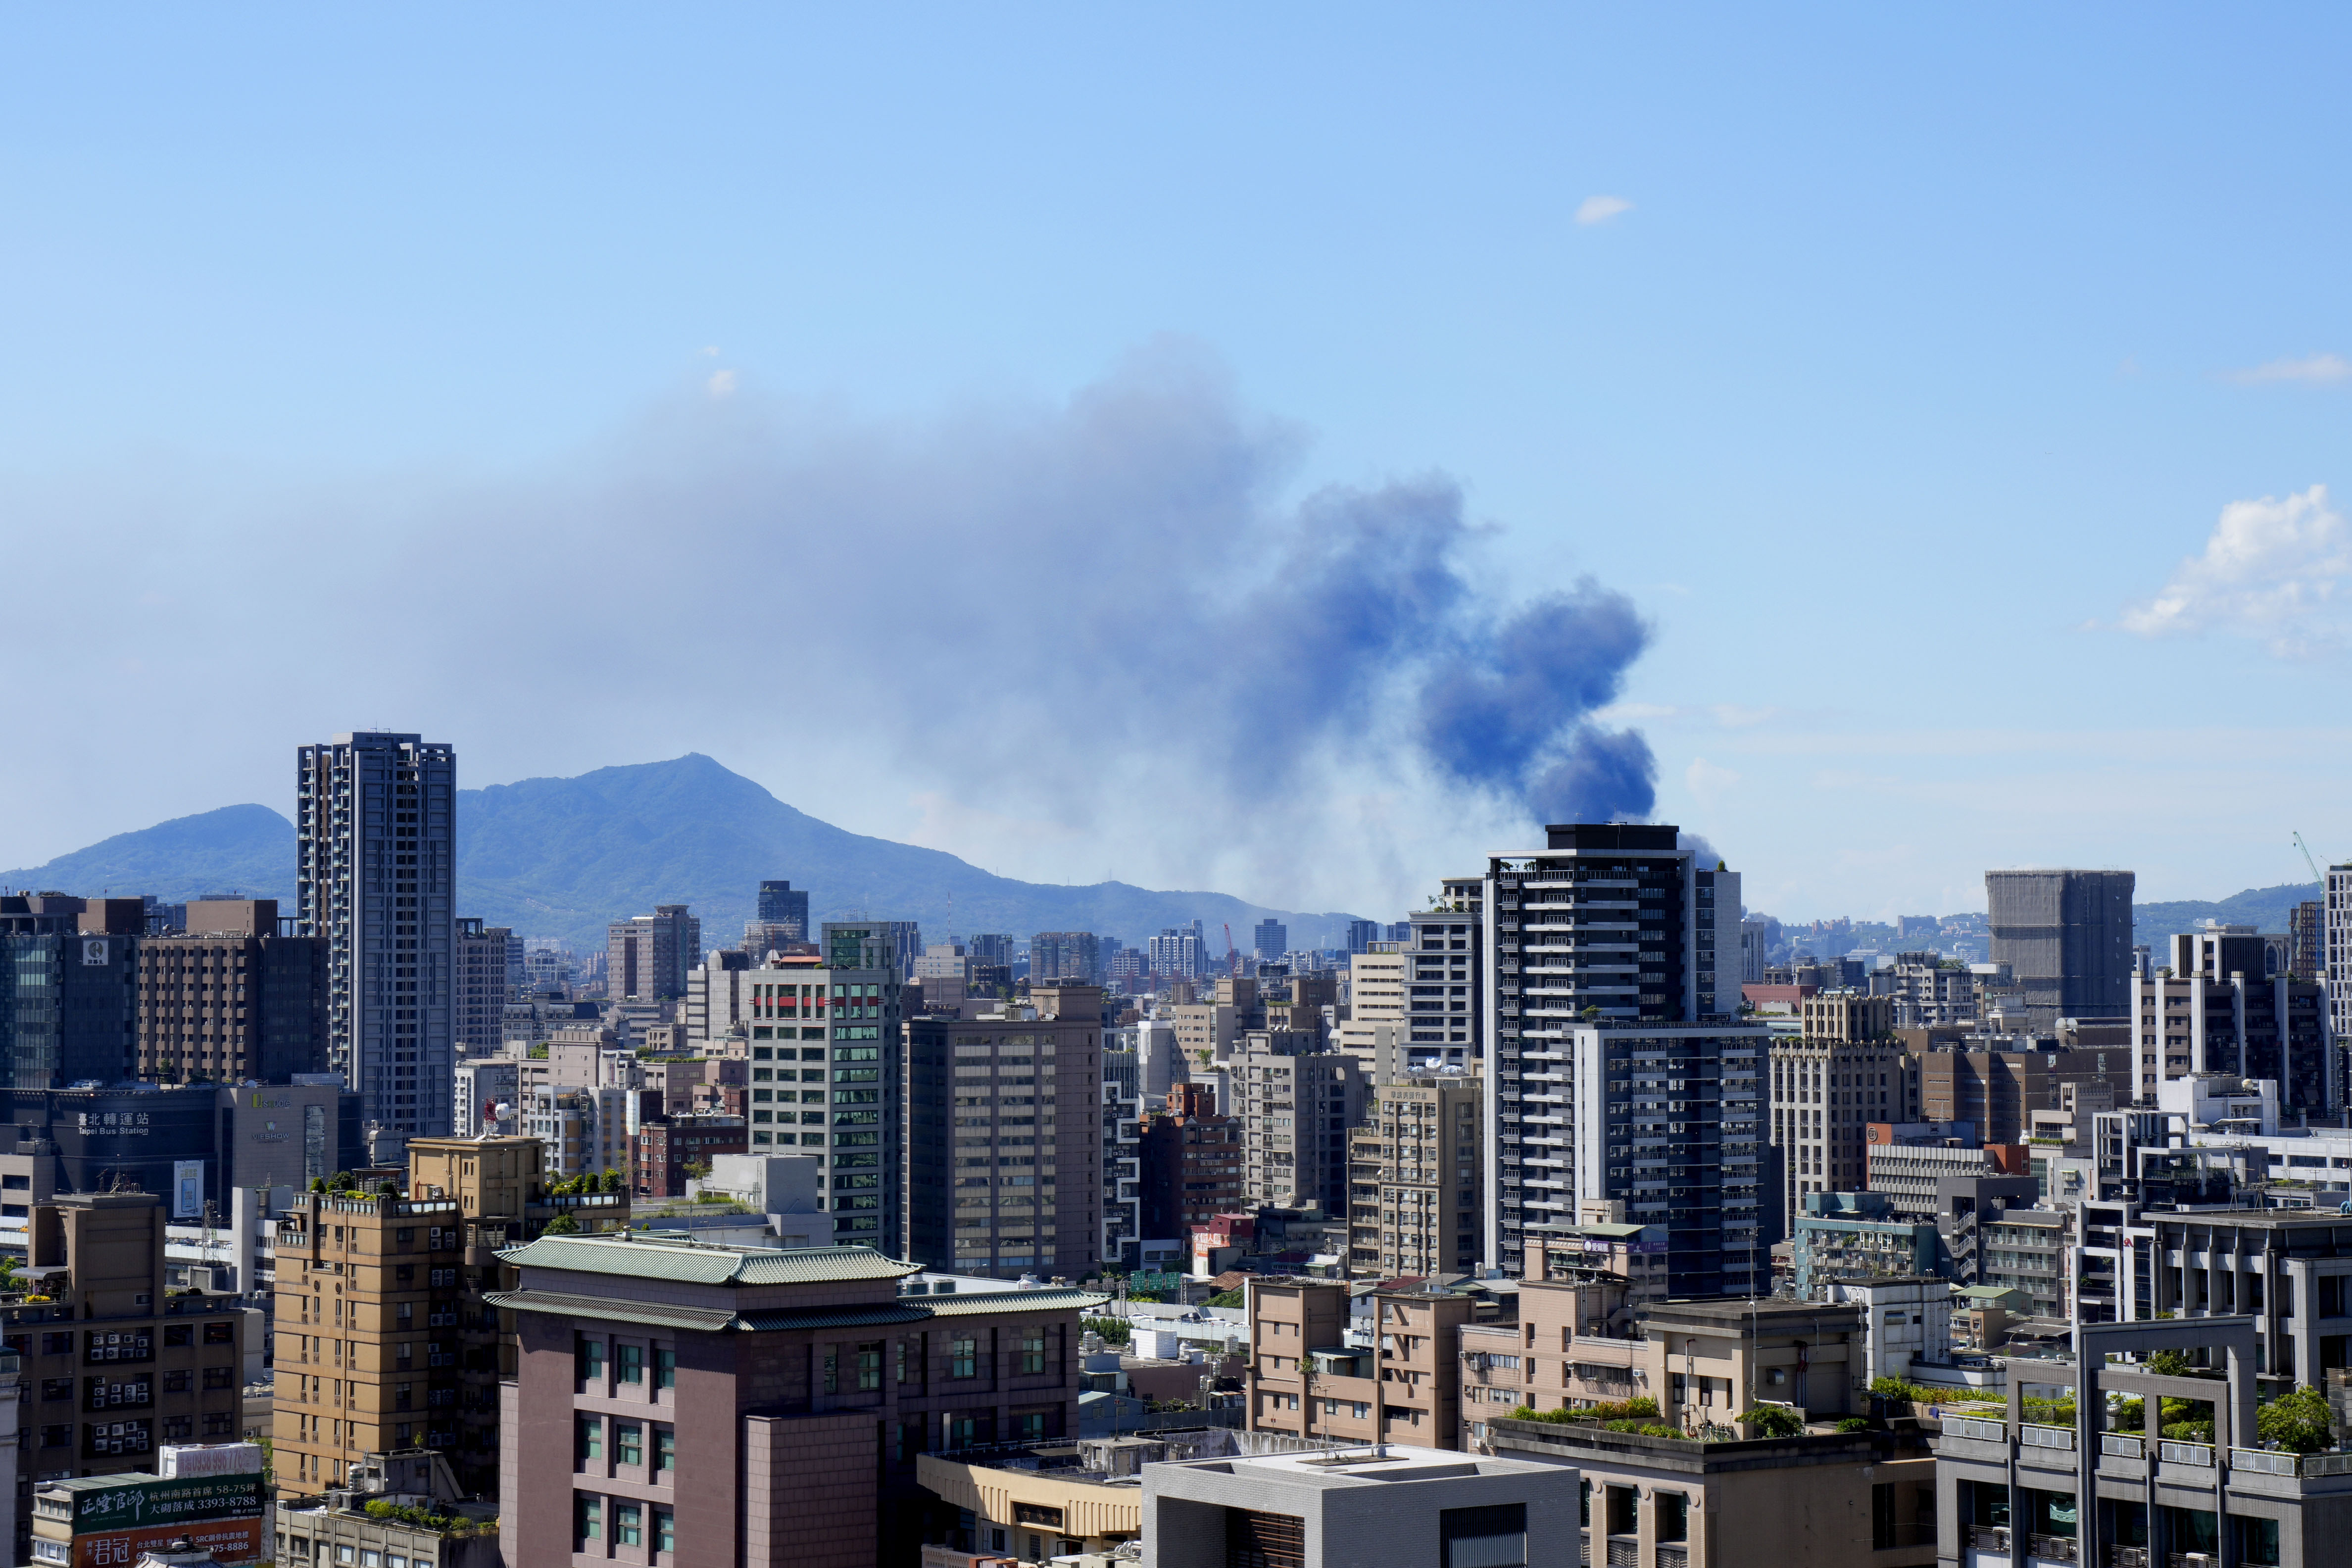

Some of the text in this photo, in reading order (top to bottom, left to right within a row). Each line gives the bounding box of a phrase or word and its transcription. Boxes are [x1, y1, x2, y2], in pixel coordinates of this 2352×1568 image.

[79, 1112, 148, 1126] 臺北轉運站
[79, 1127, 97, 1136] Taipei
[149, 1483, 256, 1502] 杭州南路首席 58-75坪
[81, 1490, 145, 1521] 正隆官邸
[149, 1496, 256, 1515] 大砌落成 3393-8788
[94, 1537, 130, 1565] 君冠
[137, 1539, 164, 1549] 台北雙星
